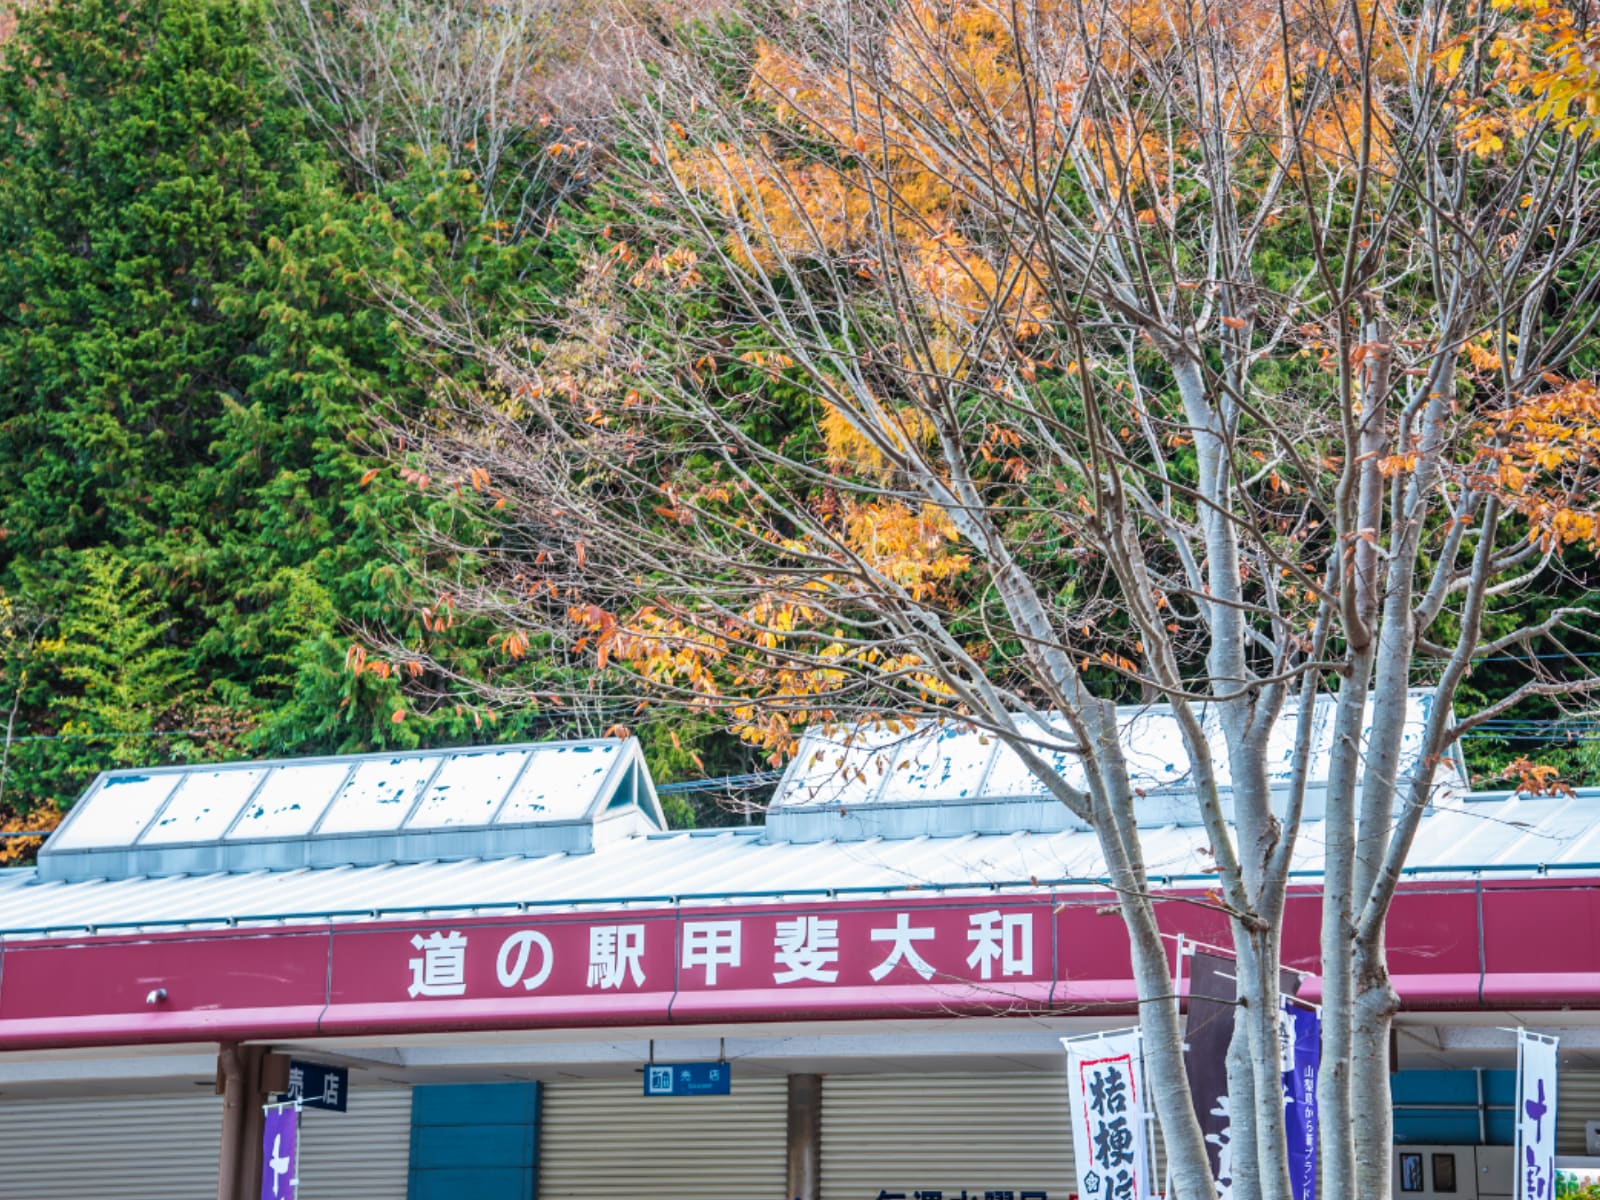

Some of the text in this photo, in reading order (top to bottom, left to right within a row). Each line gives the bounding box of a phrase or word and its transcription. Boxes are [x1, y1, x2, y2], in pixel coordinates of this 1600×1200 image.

[407, 911, 1035, 998] 道の駅甲斐大和
[288, 1068, 340, 1105] 売店
